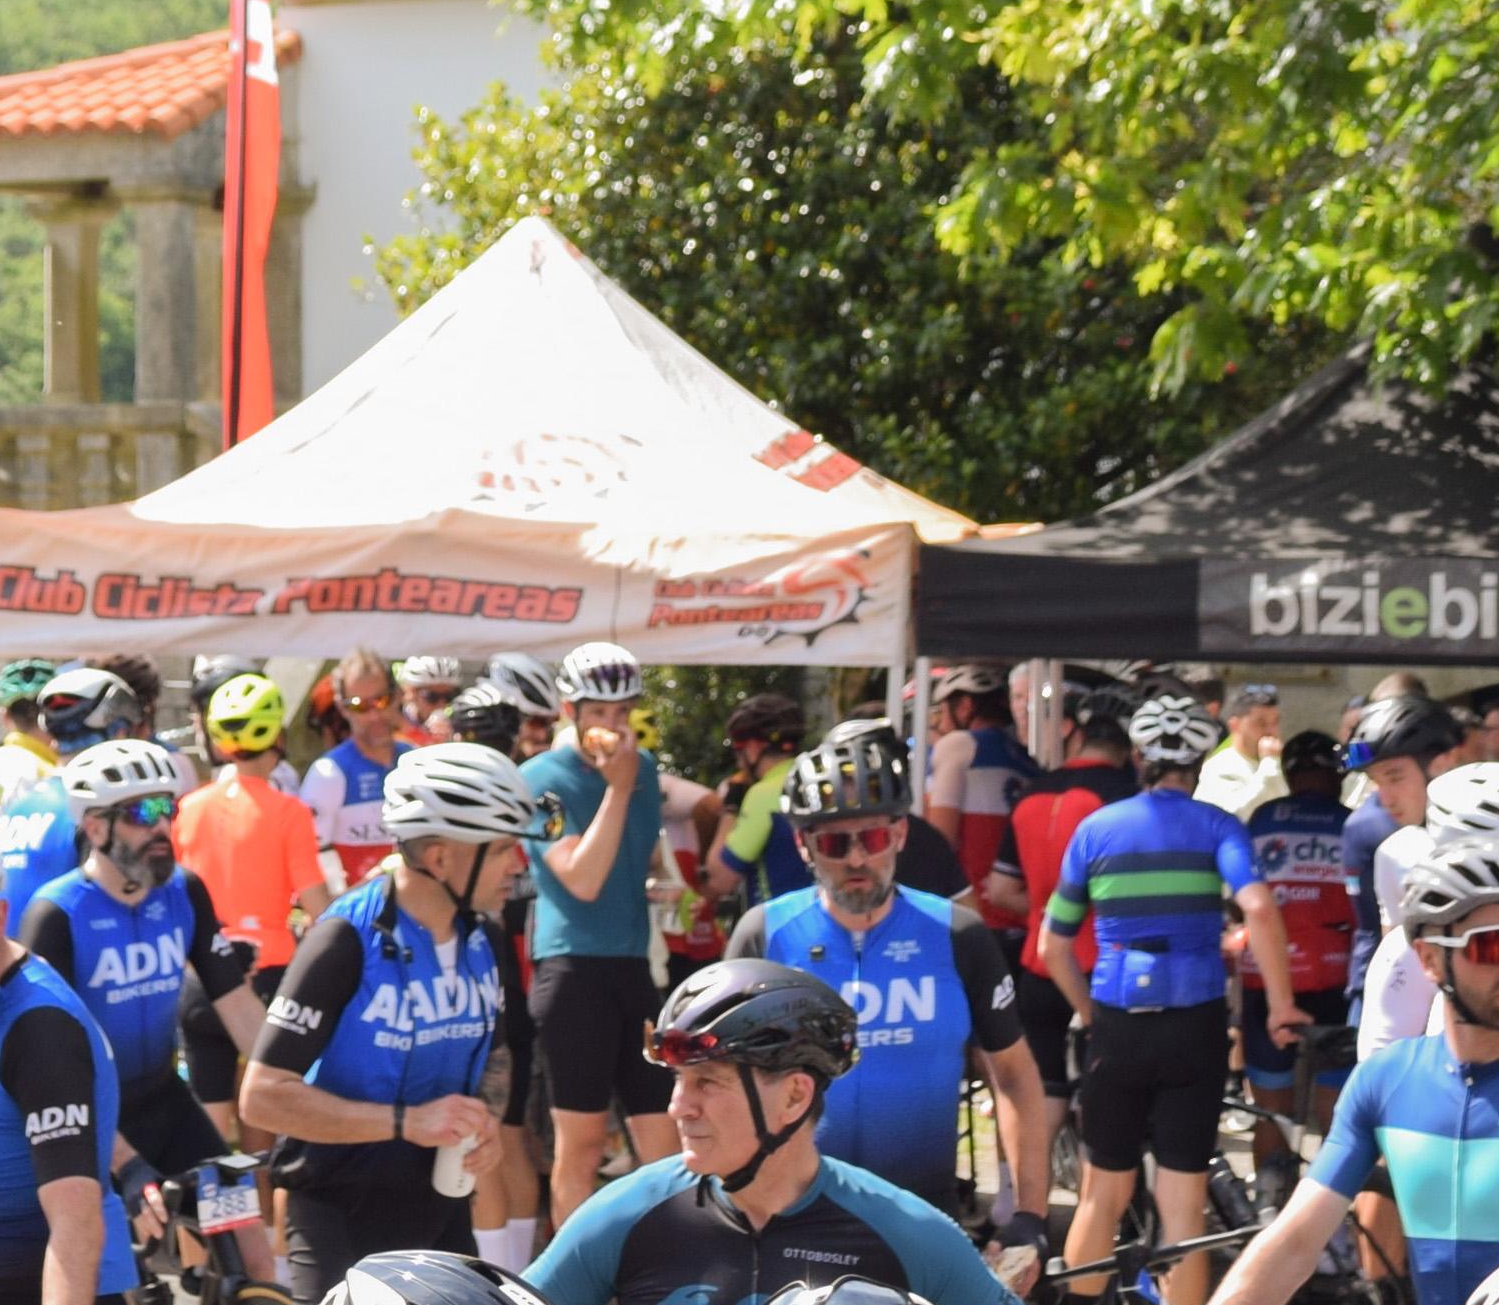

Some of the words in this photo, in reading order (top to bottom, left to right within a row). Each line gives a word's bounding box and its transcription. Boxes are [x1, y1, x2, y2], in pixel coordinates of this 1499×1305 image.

[93, 572, 265, 622] Ciclista
[271, 567, 585, 625] Ponteareas
[88, 926, 187, 989] ADN
[106, 976, 181, 1006] BIKERS
[841, 975, 936, 1025] DN
[266, 995, 323, 1031] ADN
[25, 1103, 89, 1139] ADN
[30, 1123, 82, 1146] BIKERS
[782, 1248, 860, 1267] OTTOBOSLEY
